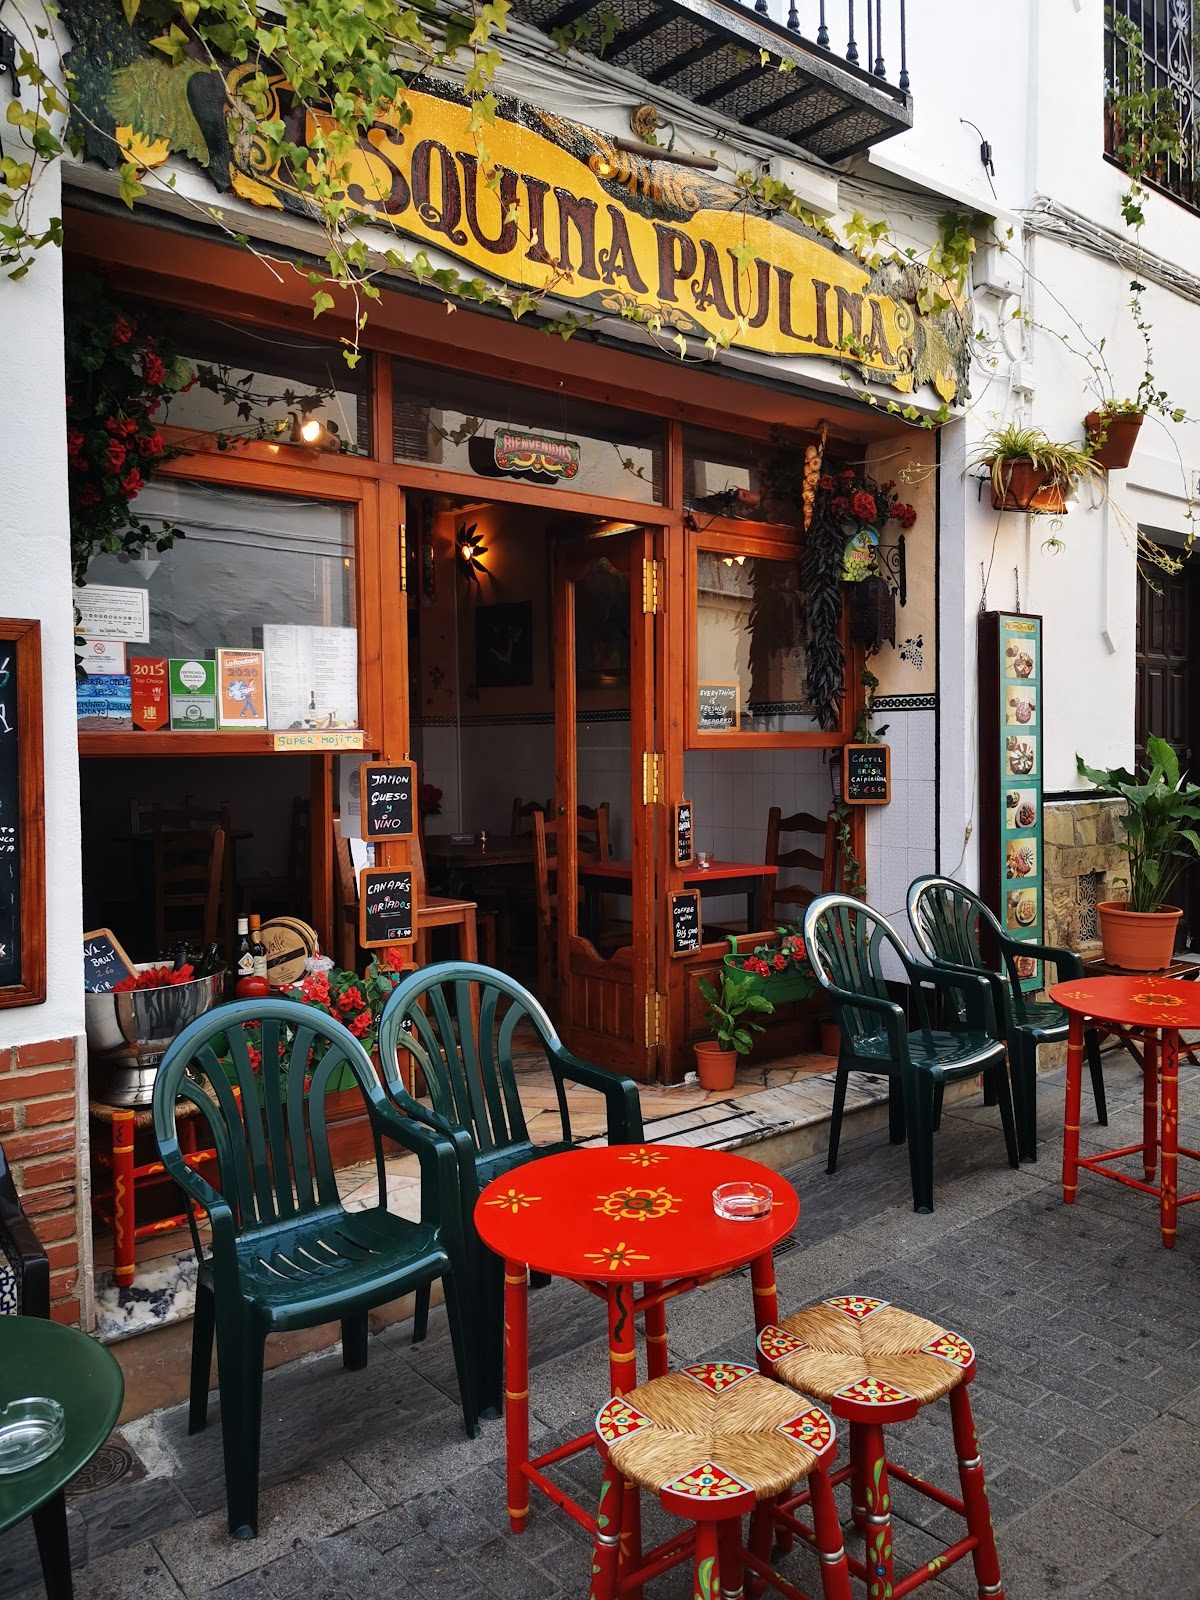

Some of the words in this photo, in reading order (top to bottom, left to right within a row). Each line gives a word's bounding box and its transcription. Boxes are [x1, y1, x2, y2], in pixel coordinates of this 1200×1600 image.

[653, 222, 896, 366] PAULINA
[503, 434, 573, 463] BIENVENIDOS
[233, 656, 259, 665] Routard
[133, 662, 165, 676] 2015
[227, 668, 258, 676] 2020
[700, 689, 736, 699] EVERYTHING
[701, 704, 728, 715] FRESHLY
[277, 736, 314, 746] SUPER
[371, 775, 410, 787] JAMON
[371, 791, 408, 806] QUESO
[374, 814, 401, 831] VINO
[367, 878, 411, 895] CANAPÉS
[367, 895, 411, 915] VARIADOS
[673, 906, 695, 915] COFFEE
[90, 949, 115, 967] BRUT
[92, 980, 114, 993] KIR
